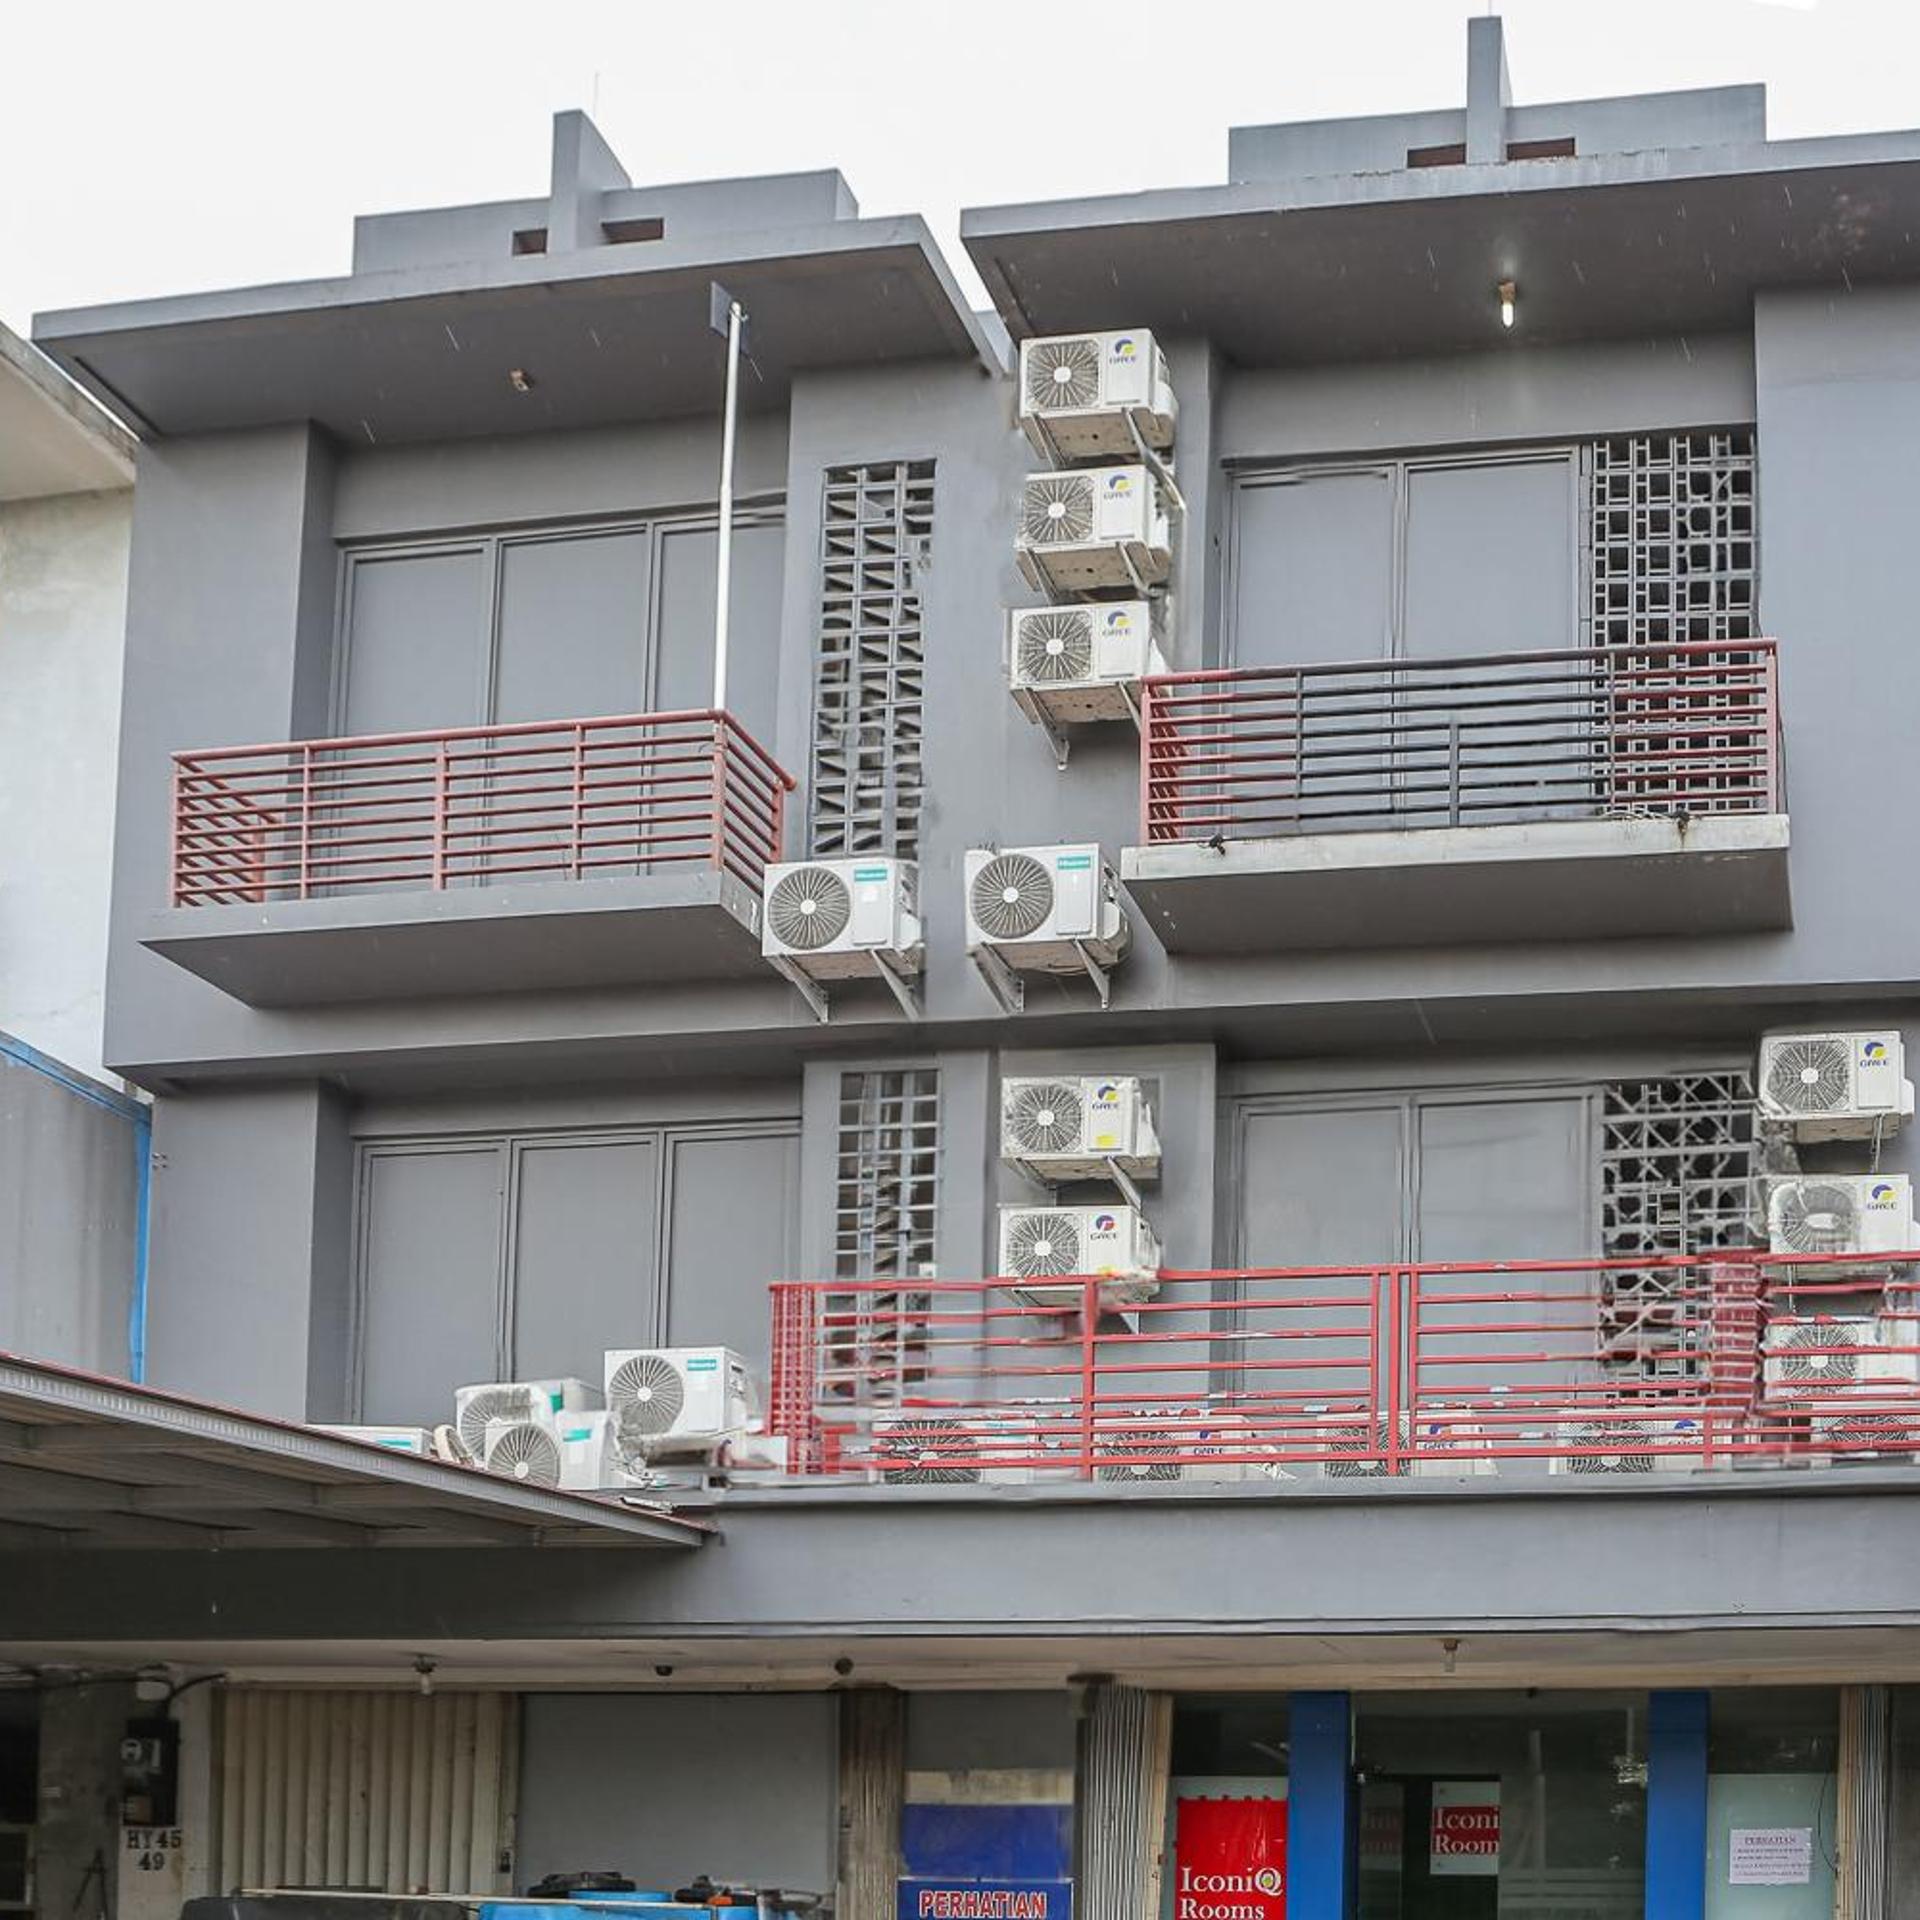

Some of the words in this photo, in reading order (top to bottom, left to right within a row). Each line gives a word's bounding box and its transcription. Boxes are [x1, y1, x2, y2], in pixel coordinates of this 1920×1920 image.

[137, 1851, 165, 1871] 49
[1181, 1867, 1283, 1896] IconiQ
[919, 1890, 1047, 1919] PERHATIAN
[1180, 1898, 1265, 1919] Rooms
